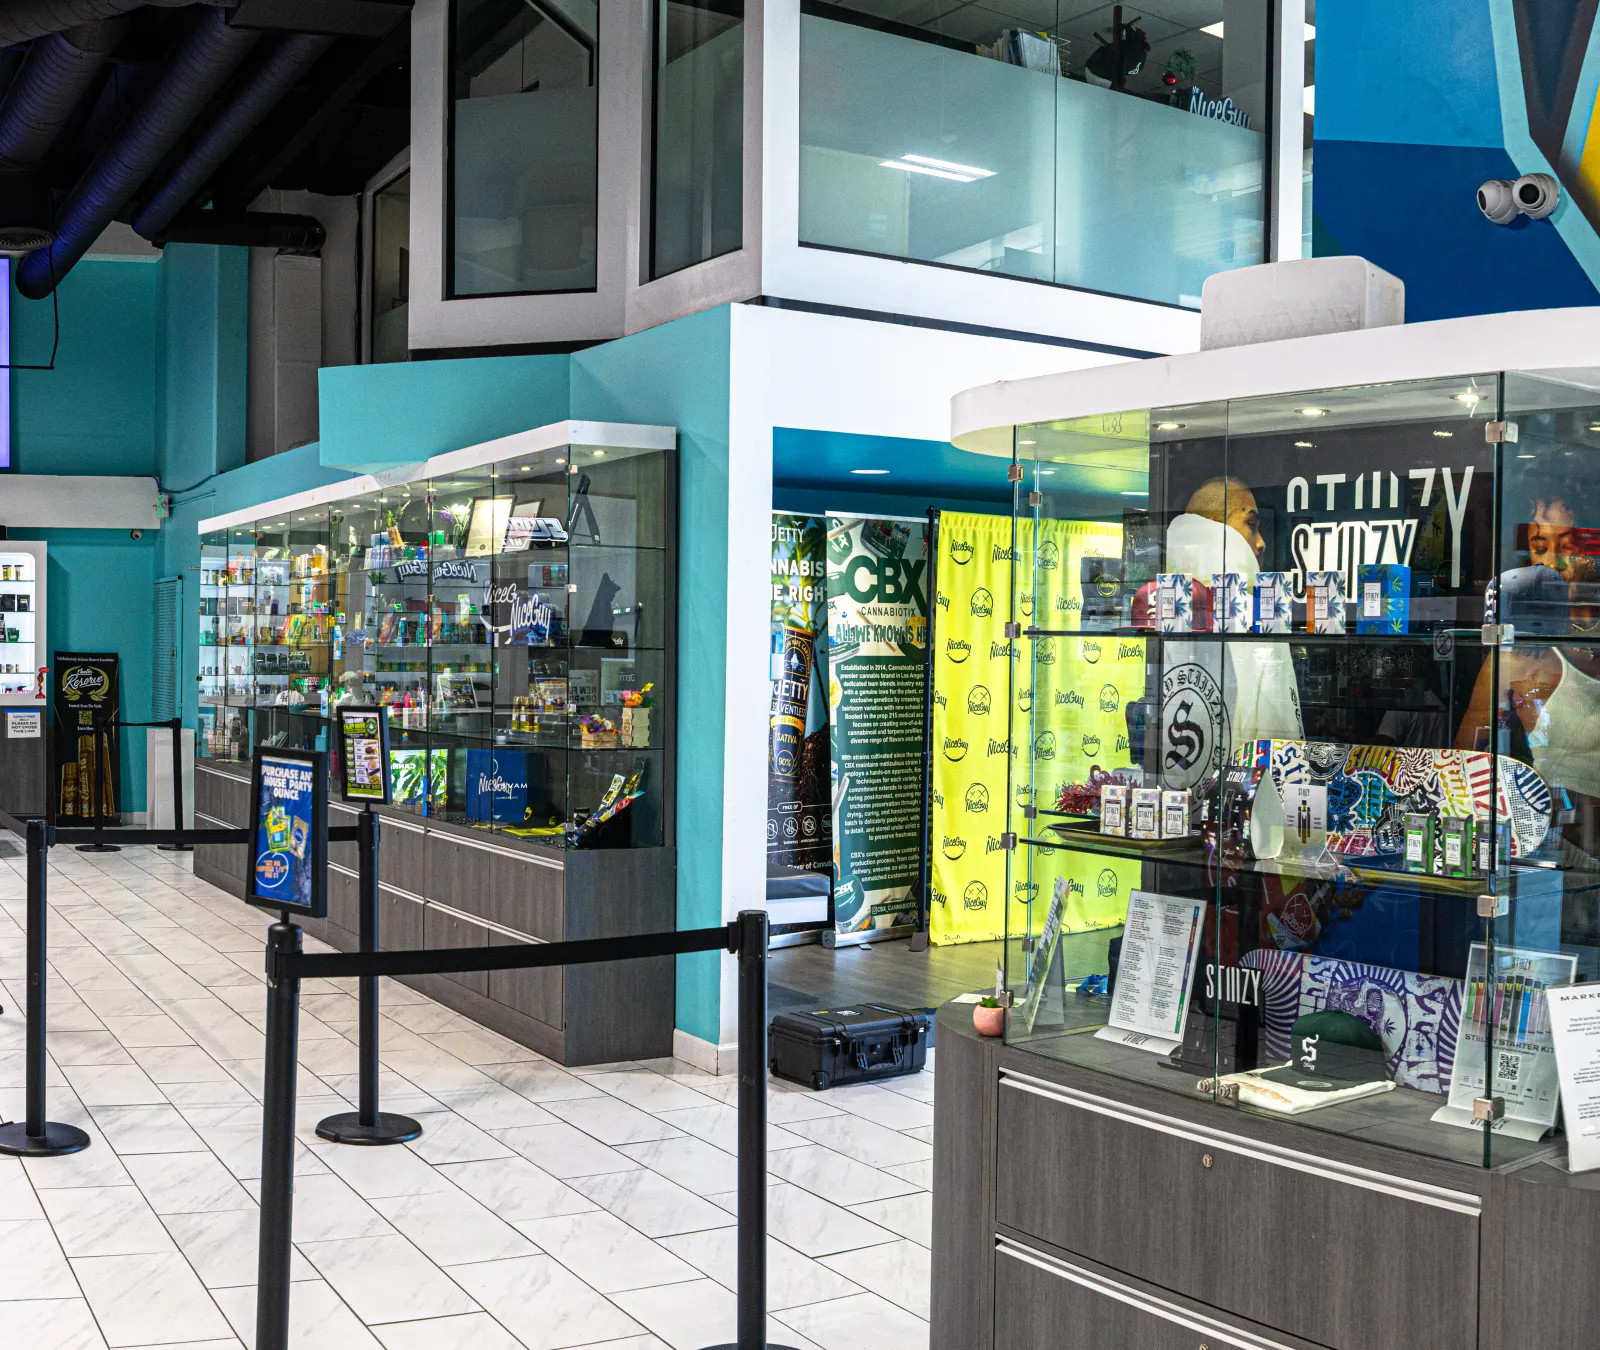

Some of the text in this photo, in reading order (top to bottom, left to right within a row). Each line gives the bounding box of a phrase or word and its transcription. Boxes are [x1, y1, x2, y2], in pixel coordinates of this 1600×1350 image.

[771, 521, 805, 542] JETTY
[950, 539, 975, 554] NiceGuy
[771, 558, 824, 577] NNABIS
[846, 555, 927, 617] CBX
[789, 585, 827, 602] RIGH
[861, 607, 916, 617] CANNABIOTIX
[970, 602, 992, 618] NiceGuy
[511, 593, 551, 645] NiceGuy
[947, 638, 972, 652] NiceGuy
[63, 674, 103, 691] Reserve
[968, 700, 991, 715] NiceGuy
[880, 720, 898, 728] creating
[777, 733, 797, 745] SATIVA
[1165, 700, 1204, 770] S
[943, 737, 968, 751] NiceGuy
[778, 757, 791, 767] 90%
[261, 765, 312, 781] PURCHASE AN
[264, 776, 312, 792] HOUSE PARTY
[273, 788, 299, 800] OUNCE
[942, 835, 967, 849] NiceGuy
[866, 849, 900, 858] comprehensive
[850, 860, 876, 868] production
[861, 874, 887, 882] unmatched
[964, 898, 987, 910] NiceGuy
[1500, 1039, 1539, 1052] STARTER
